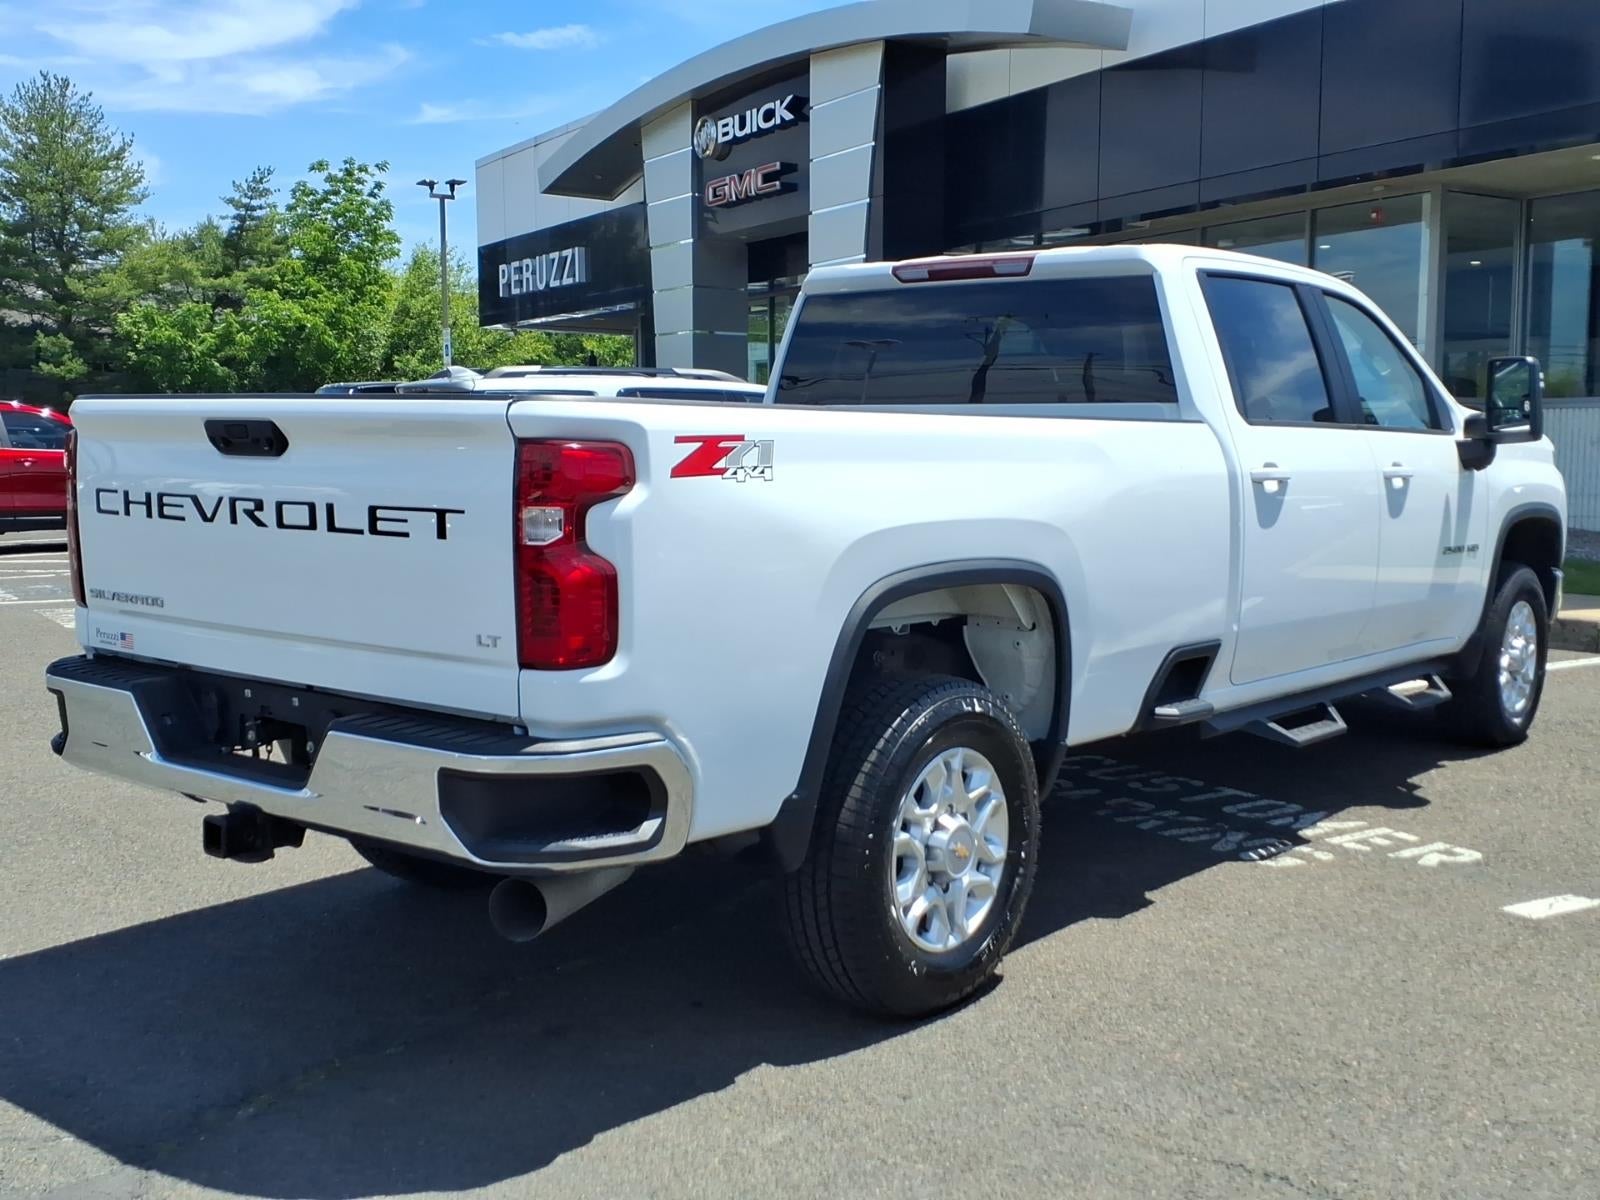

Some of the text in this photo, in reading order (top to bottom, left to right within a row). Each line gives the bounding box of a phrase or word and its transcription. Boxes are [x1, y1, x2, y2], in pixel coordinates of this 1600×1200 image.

[717, 94, 796, 144] BUICK
[705, 162, 782, 207] GMC
[499, 247, 585, 297] PERUZZI
[670, 434, 774, 478] Z71
[95, 488, 465, 540] CHEVROLET
[90, 588, 164, 608] SILVERADO
[96, 627, 119, 641] Peruzzi
[476, 634, 502, 648] LT
[1062, 755, 1482, 867] CUSTOMER
